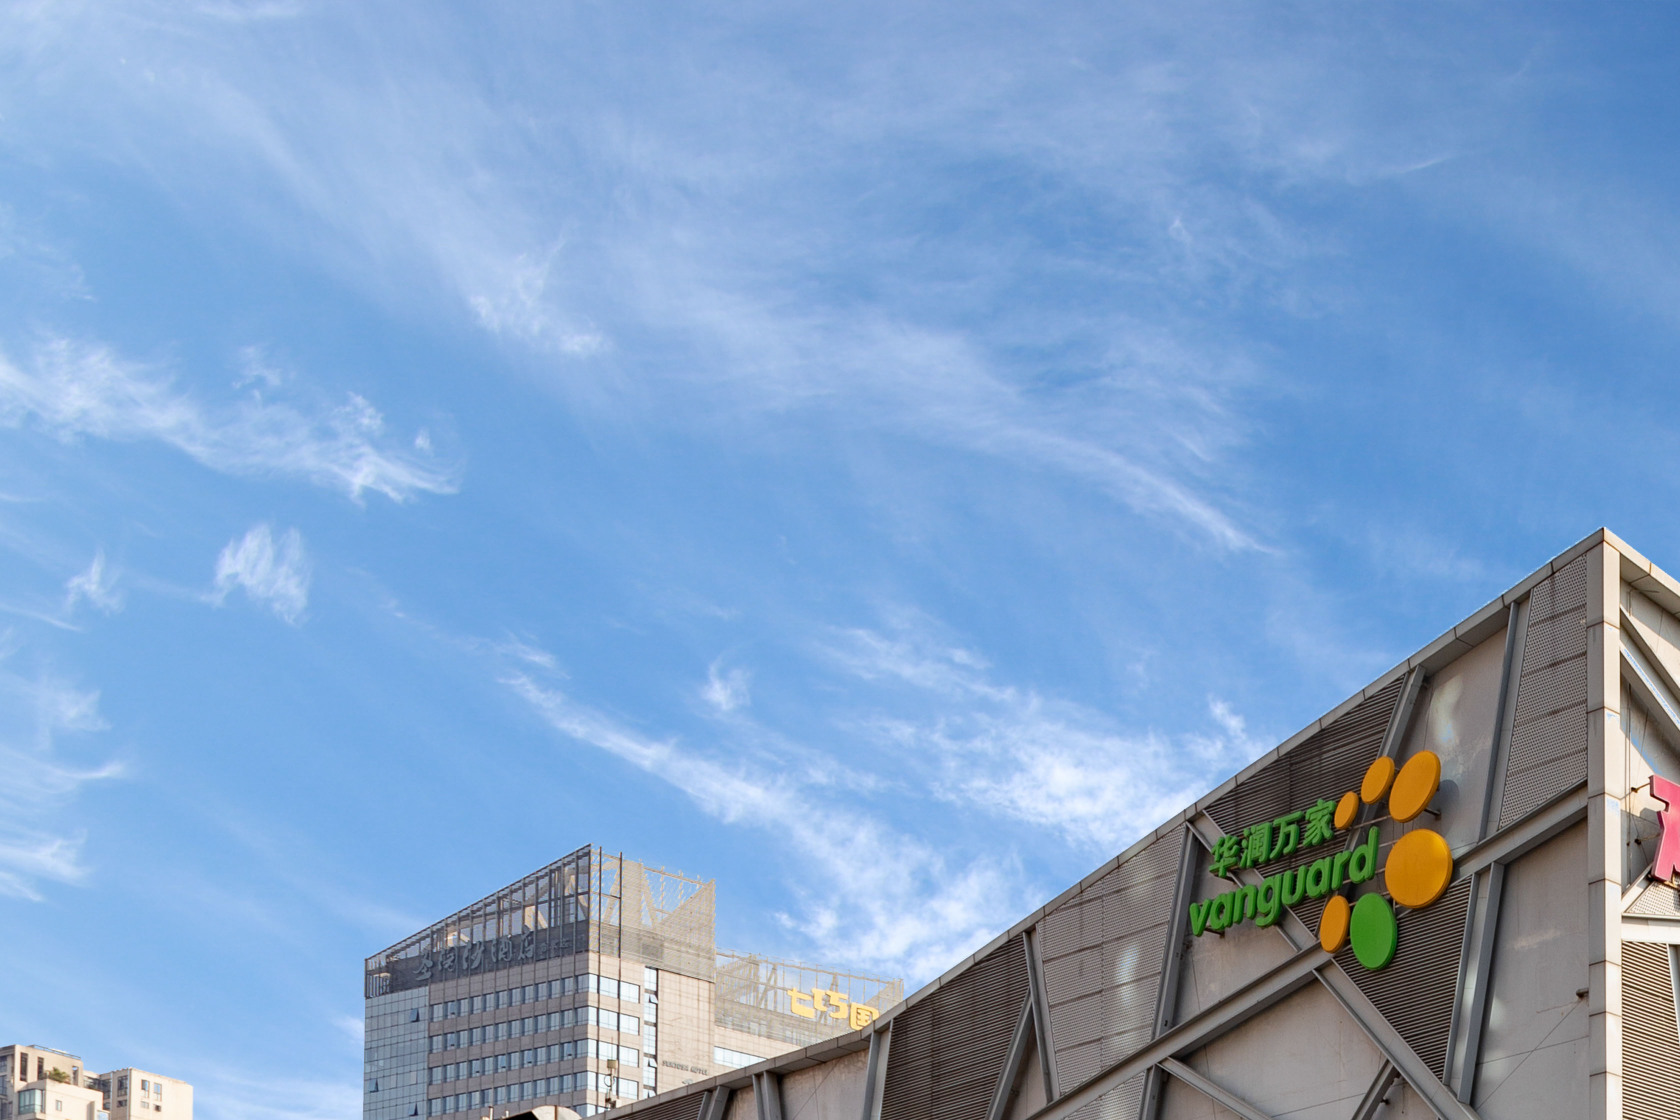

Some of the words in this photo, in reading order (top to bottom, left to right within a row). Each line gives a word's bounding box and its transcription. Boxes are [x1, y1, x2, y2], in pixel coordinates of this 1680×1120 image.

[1189, 826, 1379, 937] vanguard
[1208, 798, 1337, 878] 华润万家
